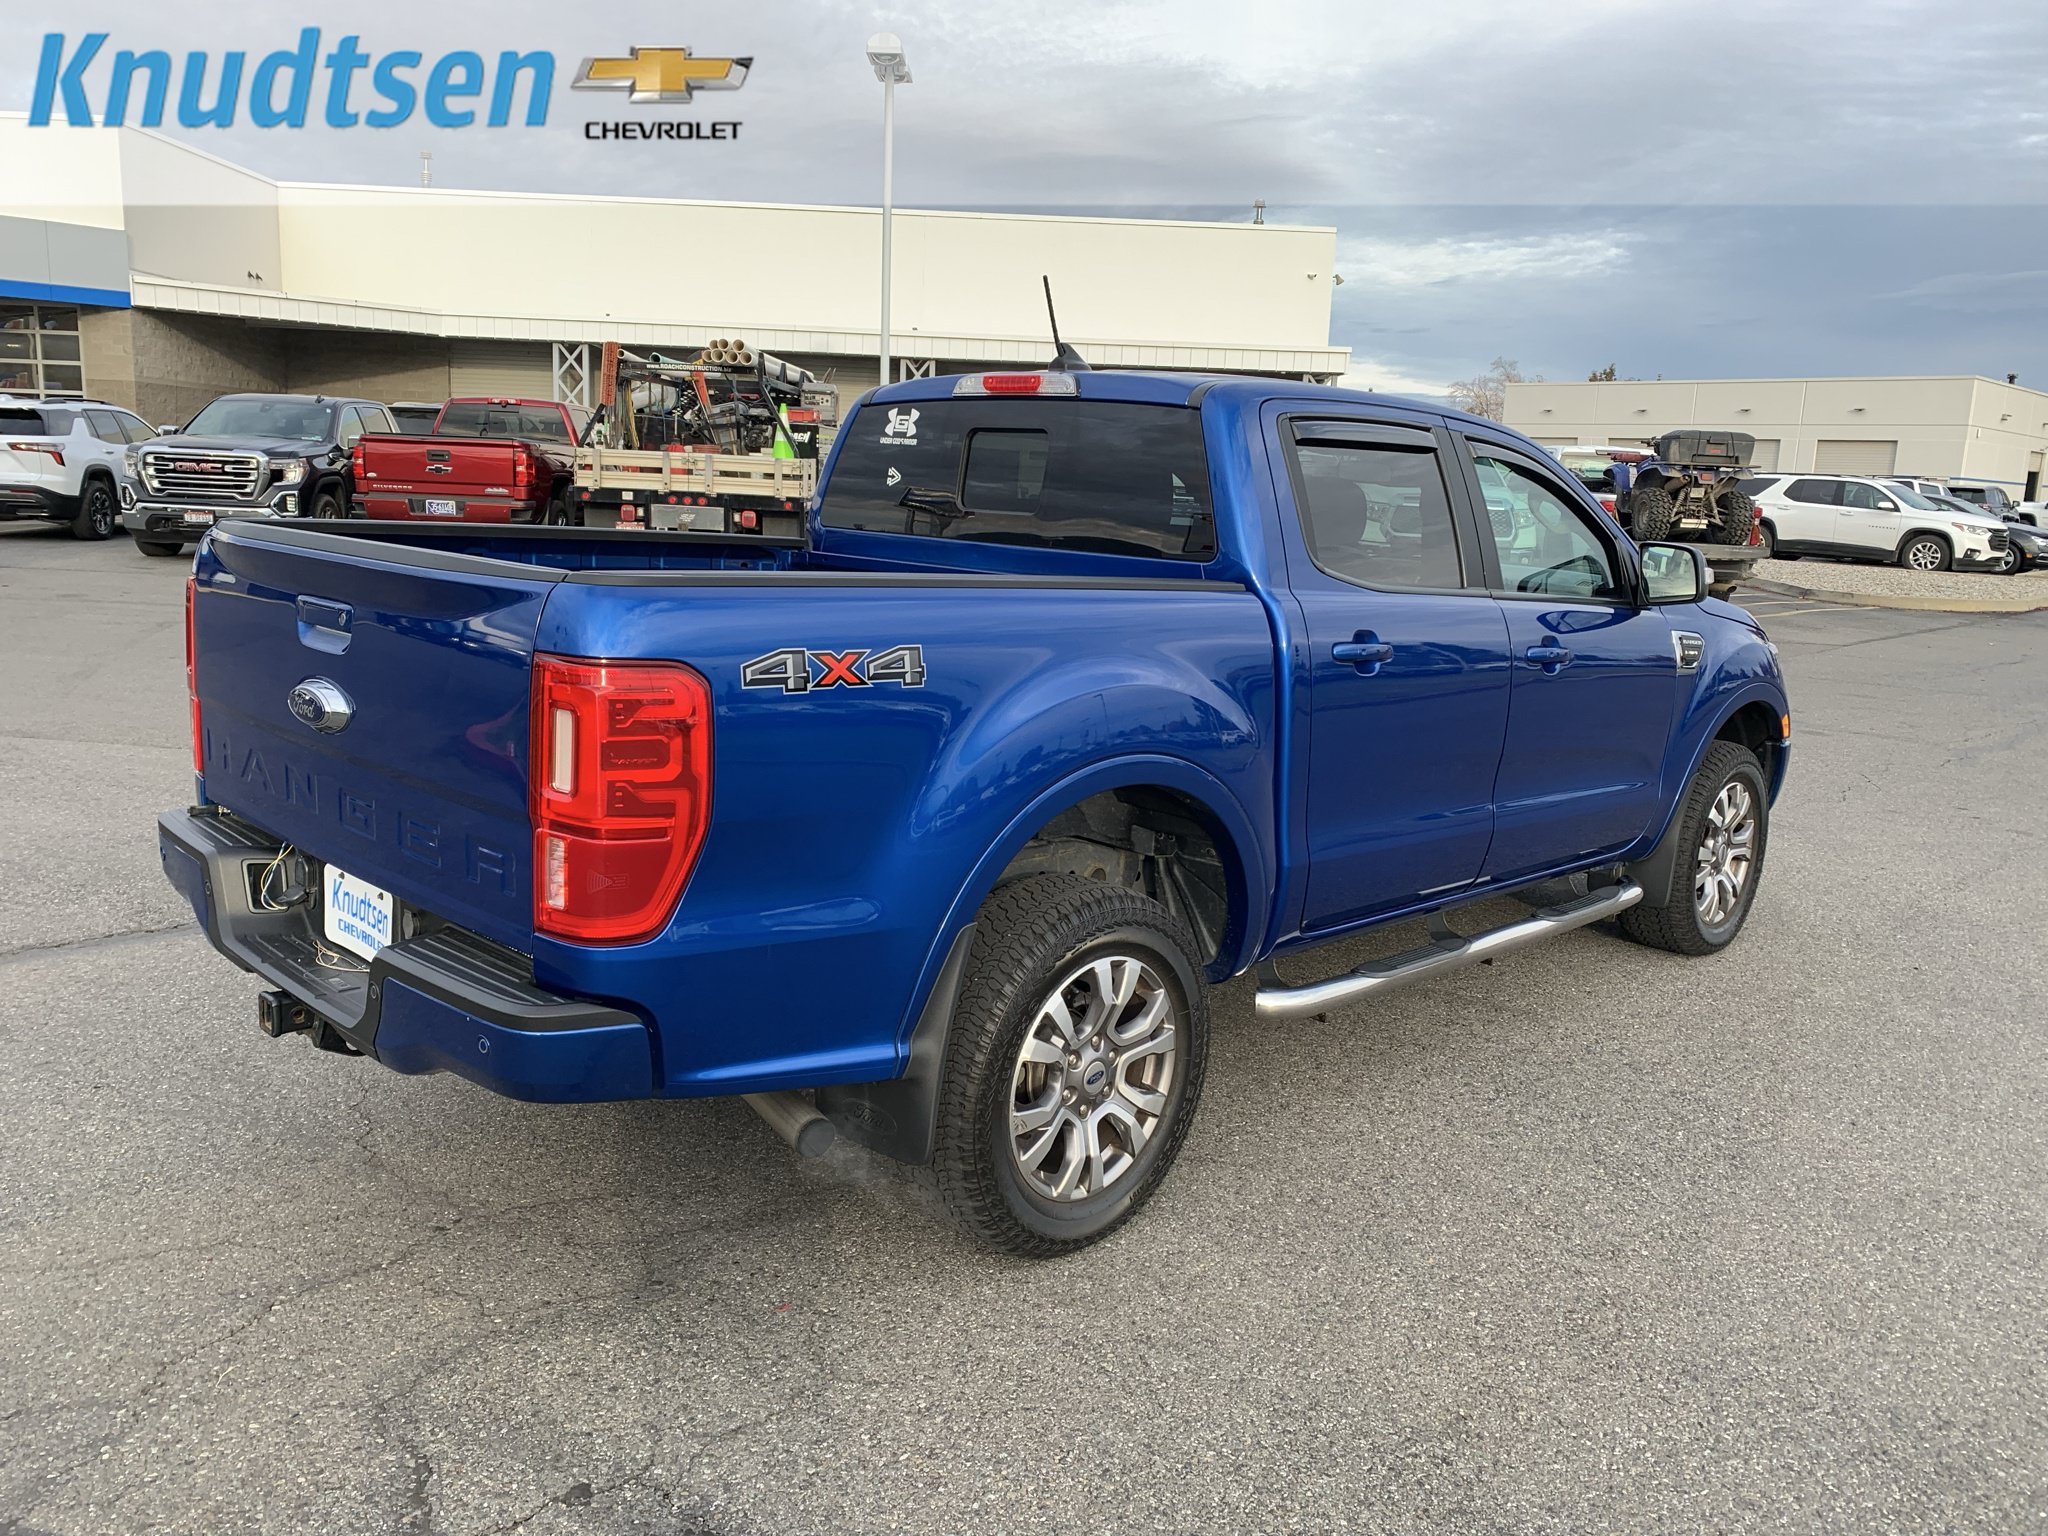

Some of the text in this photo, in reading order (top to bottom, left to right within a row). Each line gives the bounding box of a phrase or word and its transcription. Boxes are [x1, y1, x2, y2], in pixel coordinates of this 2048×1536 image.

[175, 461, 223, 473] GMC
[292, 690, 316, 718] Ford
[205, 726, 518, 898] RANGER
[331, 878, 389, 939] Knudtsen
[338, 918, 385, 951] CHEVROLE
